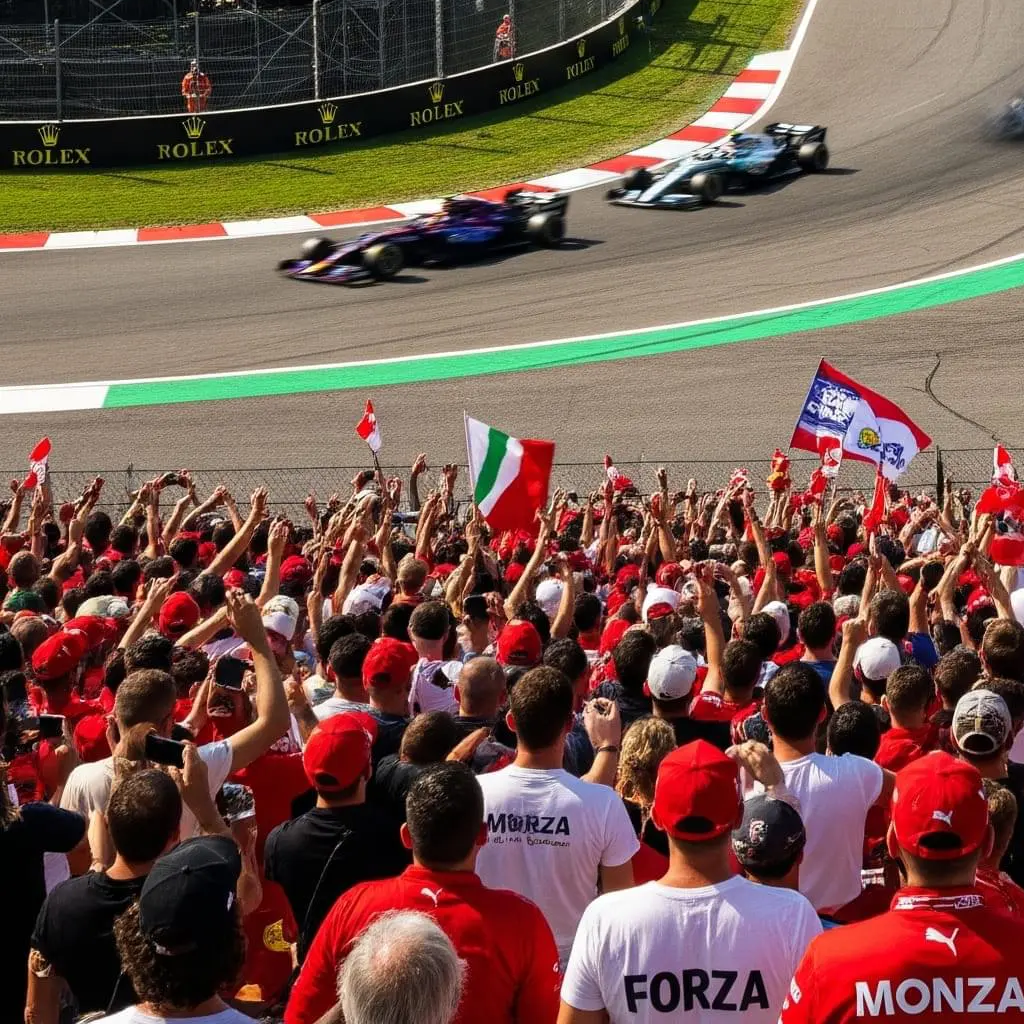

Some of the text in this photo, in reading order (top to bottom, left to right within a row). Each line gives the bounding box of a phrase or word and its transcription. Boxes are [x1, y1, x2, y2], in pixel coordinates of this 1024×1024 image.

[410, 99, 464, 126] ROLEX
[294, 121, 362, 146] ROLEX
[12, 147, 91, 166] ROLEX
[157, 138, 234, 159] ROLEX
[624, 969, 770, 1014] FORZA
